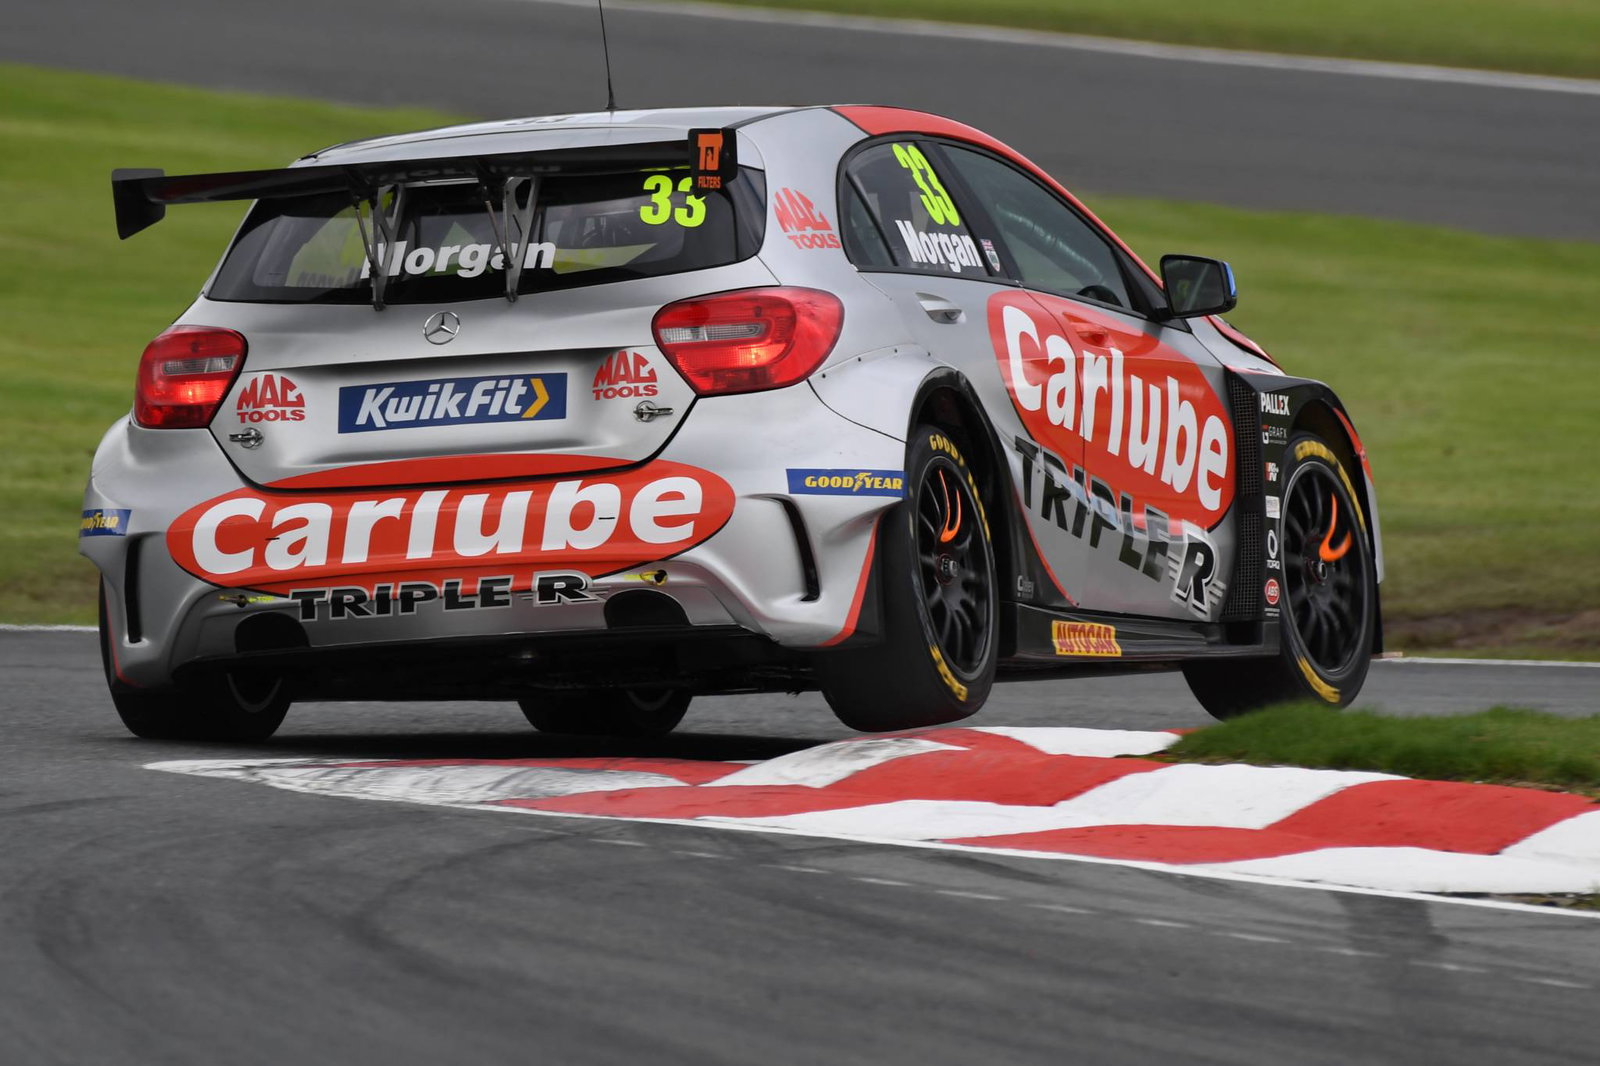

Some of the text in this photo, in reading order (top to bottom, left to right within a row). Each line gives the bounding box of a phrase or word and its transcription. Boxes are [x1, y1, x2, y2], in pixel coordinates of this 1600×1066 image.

[640, 174, 707, 228] 33
[698, 176, 721, 189] FILTERS
[892, 143, 960, 226] 33
[787, 233, 842, 250] TOOLS
[895, 219, 984, 273] Morgan
[236, 408, 306, 424] TOOLS
[592, 384, 658, 401] TOOLS
[1002, 305, 1229, 512] Carlube
[192, 475, 703, 575] Carlube
[1015, 436, 1222, 622] TRIPLE R
[289, 569, 600, 622] TRIPLE R
[1056, 623, 1119, 654] AUTOCAR
